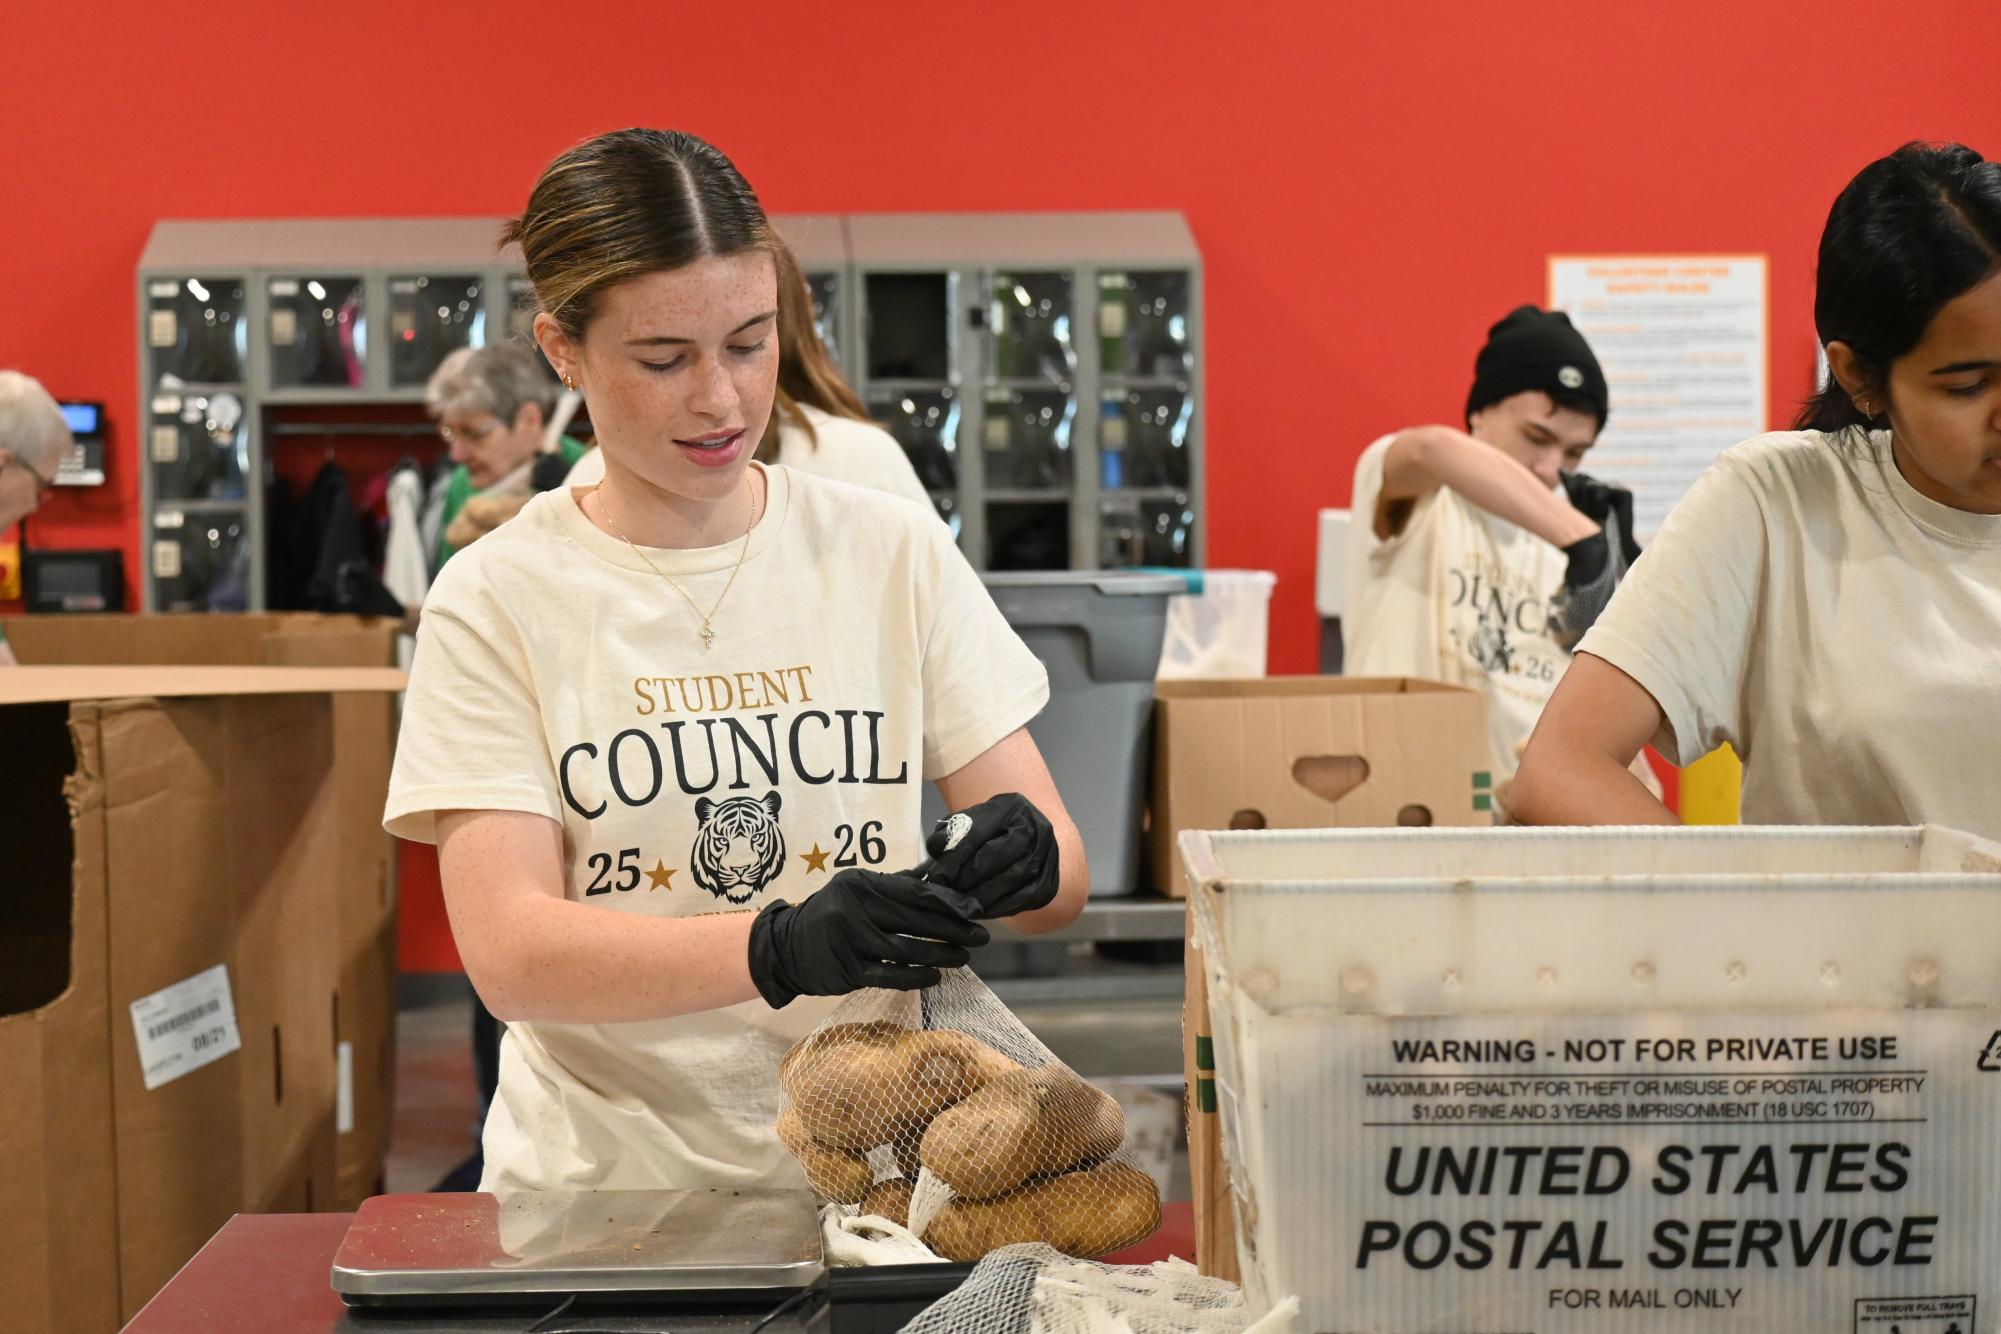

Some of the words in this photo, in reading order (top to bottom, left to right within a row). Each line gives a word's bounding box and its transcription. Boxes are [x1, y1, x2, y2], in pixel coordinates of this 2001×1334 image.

[1526, 655, 1554, 682] 26
[634, 665, 813, 716] STUDENT
[559, 709, 908, 821] COUNCIL
[585, 847, 642, 897] 25
[833, 820, 888, 869] 26
[1392, 1040, 1536, 1063] WARNING
[1564, 1039, 1625, 1062] NOT
[1635, 1039, 1696, 1062] FOR
[1706, 1037, 1829, 1061] PRIVATE
[1839, 1036, 1897, 1060] USE
[1366, 1081, 1449, 1097] MAXIMUM
[1453, 1081, 1530, 1097] PENALTY
[1534, 1081, 1570, 1096] FOR
[1574, 1080, 1630, 1096] THEFT
[1634, 1080, 1660, 1096] OR
[1664, 1080, 1729, 1096] MISUSE
[1733, 1080, 1757, 1095] OF
[1762, 1079, 1828, 1095] POSTAL
[1831, 1077, 1926, 1094] PROPERTY
[1412, 1104, 1464, 1120] $1,000
[1468, 1104, 1507, 1119] FINE
[1508, 1104, 1546, 1119] AND
[1550, 1104, 1561, 1119] 3
[1564, 1103, 1622, 1119] YEARS
[1626, 1102, 1761, 1118] IMPRISONMENT
[1763, 1102, 1788, 1121] (18
[1791, 1101, 1828, 1117] USC
[1834, 1100, 1875, 1120] 1707)
[1384, 1146, 1631, 1196] UNITED
[1652, 1142, 1912, 1195] STATES
[1355, 1220, 1625, 1270] POSTAL
[1648, 1215, 1939, 1269] SERVICE
[1549, 1289, 1601, 1309] FOR
[1608, 1289, 1667, 1309] MAIL
[1674, 1287, 1743, 1309] ONLY
[1865, 1304, 1877, 1313] TO
[1879, 1303, 1914, 1313] REMOVE
